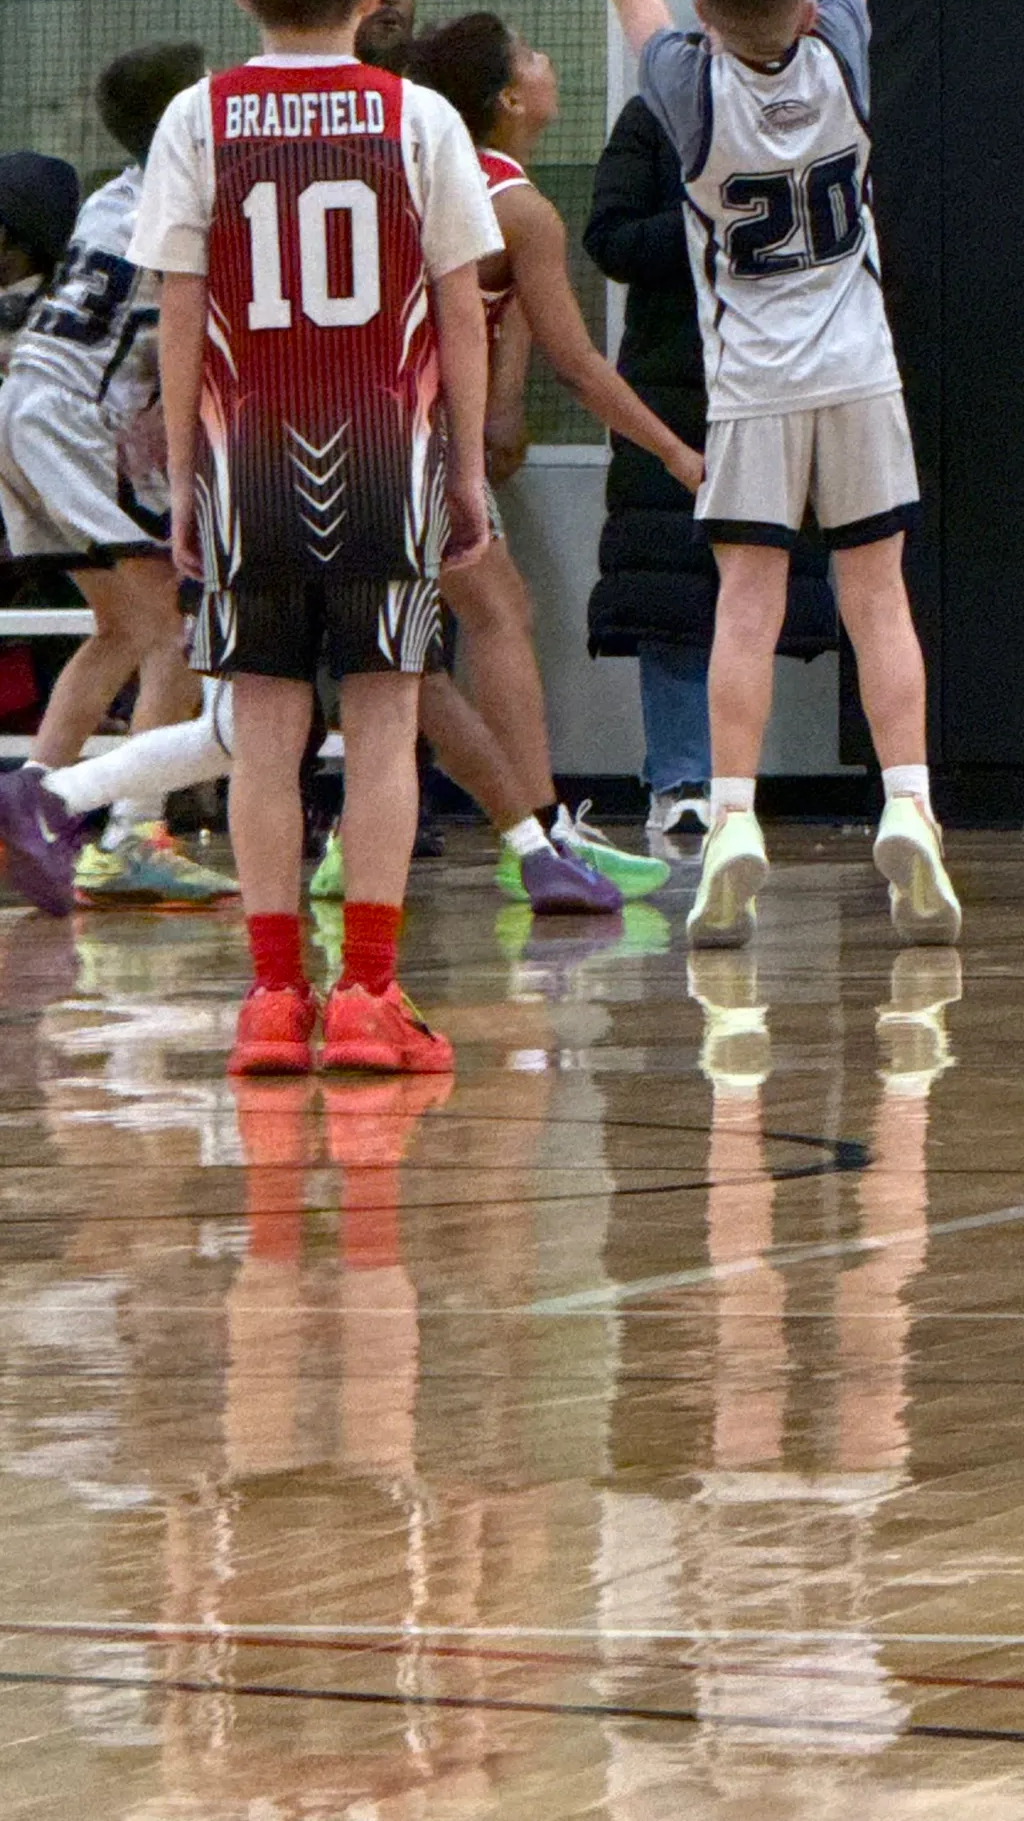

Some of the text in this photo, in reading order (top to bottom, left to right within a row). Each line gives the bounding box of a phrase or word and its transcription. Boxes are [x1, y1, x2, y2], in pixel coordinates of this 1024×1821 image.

[225, 90, 384, 138] BRADFIELD
[242, 179, 381, 331] 10
[720, 144, 866, 280] 20
